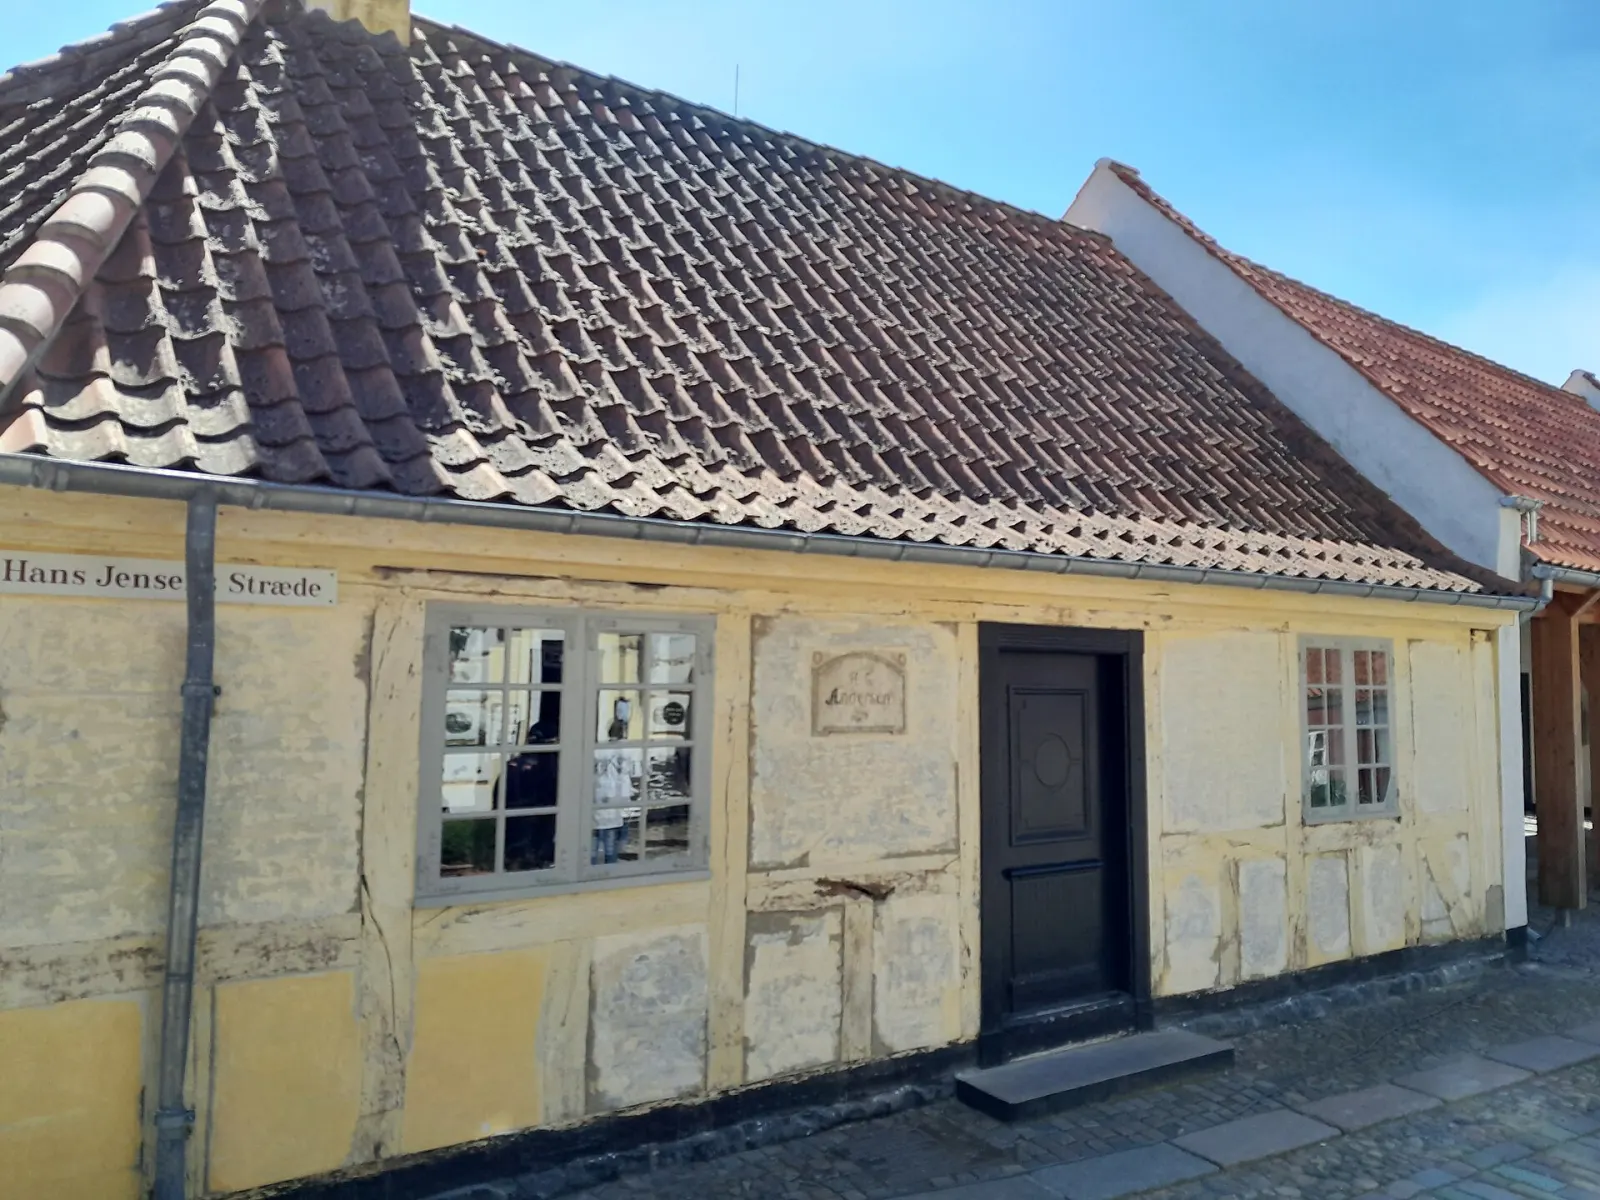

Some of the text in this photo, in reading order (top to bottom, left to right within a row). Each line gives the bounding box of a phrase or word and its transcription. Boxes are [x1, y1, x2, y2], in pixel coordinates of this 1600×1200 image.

[2, 558, 321, 597] Hans Jense Stræde
